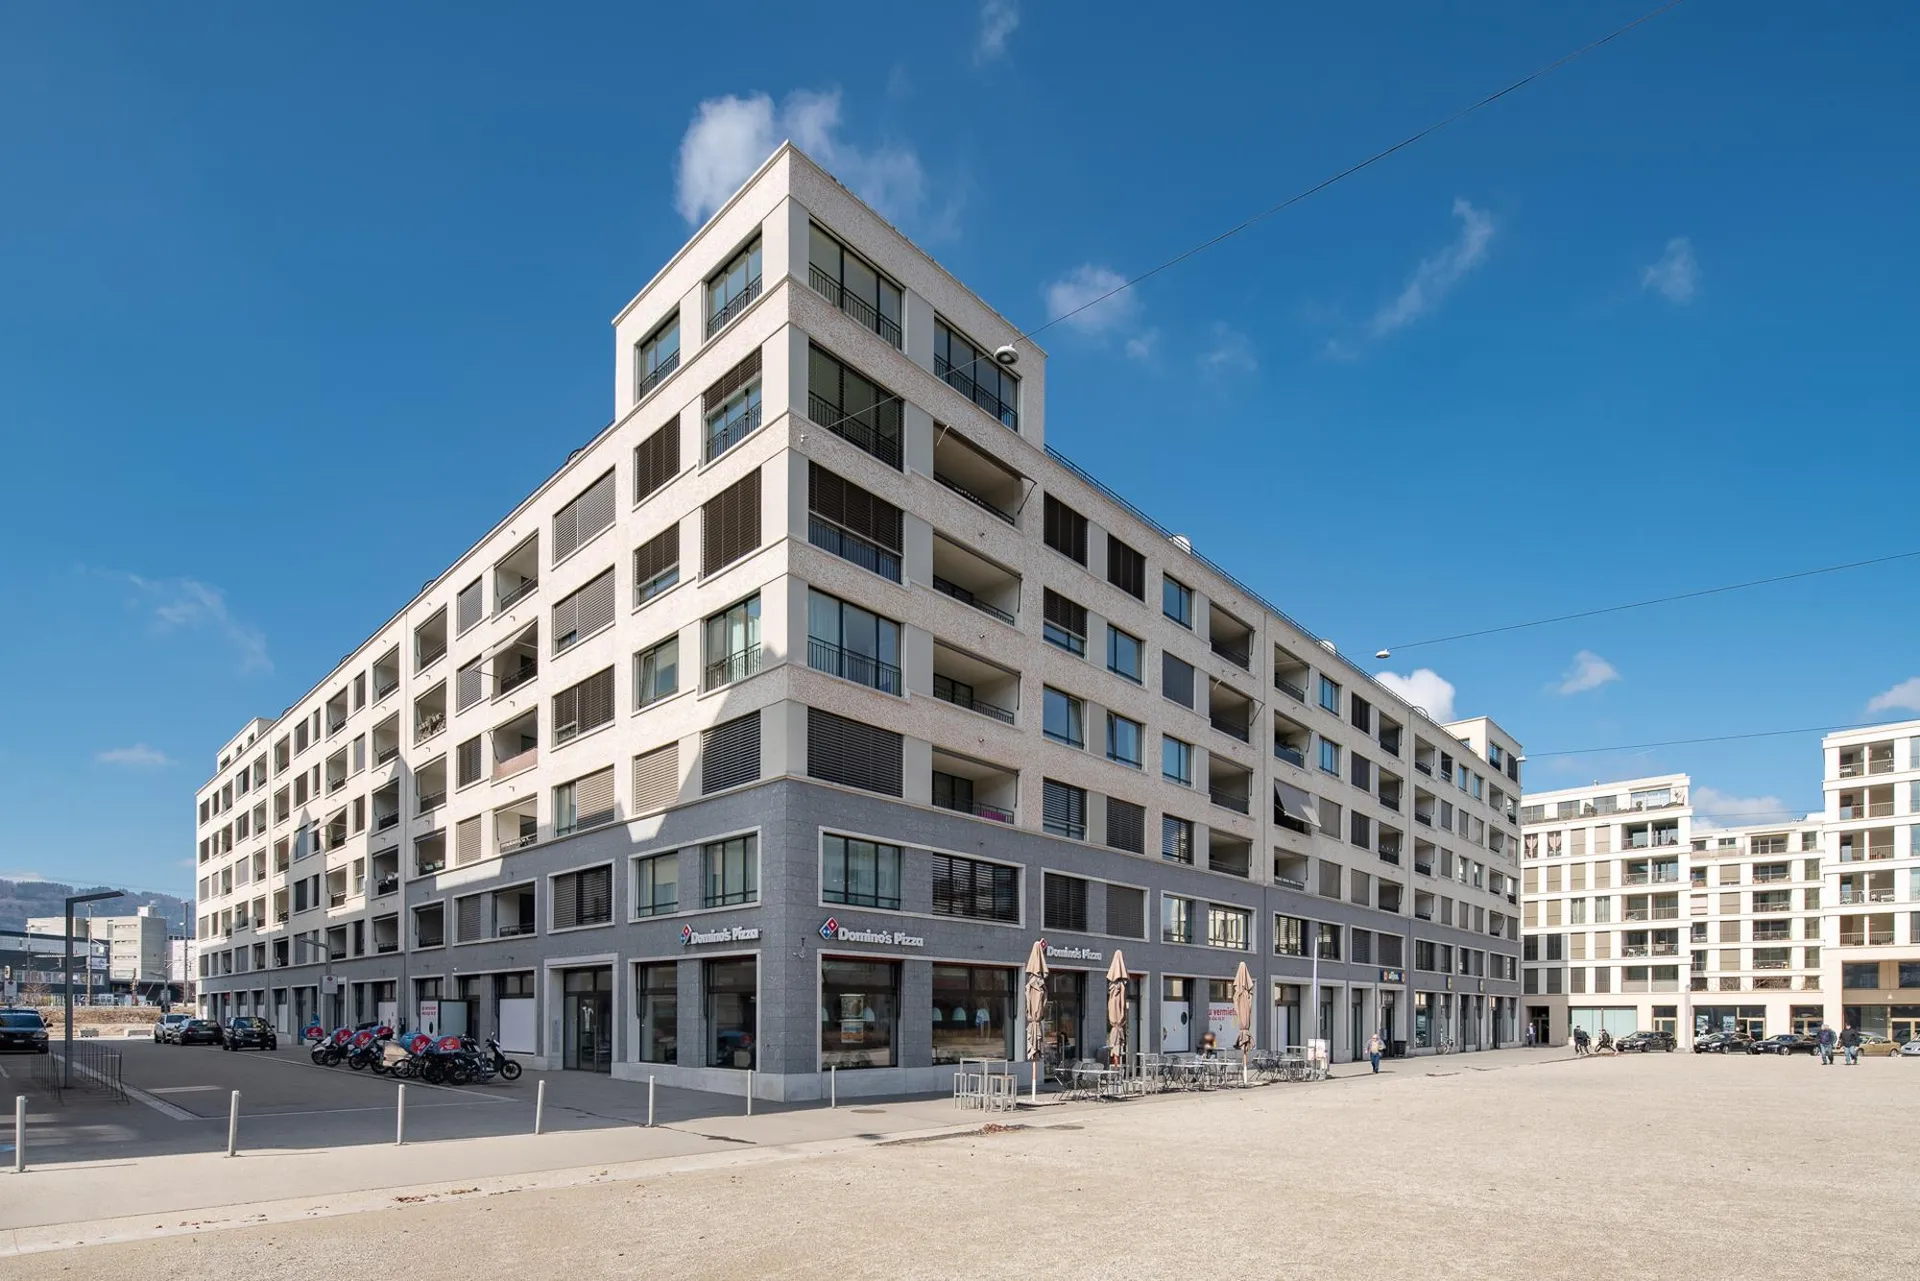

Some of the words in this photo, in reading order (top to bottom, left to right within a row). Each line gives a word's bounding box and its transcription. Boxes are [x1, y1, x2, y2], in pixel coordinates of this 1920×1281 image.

[691, 928, 732, 945] Domino's
[732, 926, 759, 941] Pizza
[838, 927, 893, 945] Domino's
[893, 932, 924, 947] Pizza
[1046, 945, 1082, 959] Domino's
[1082, 948, 1102, 960] Pizza
